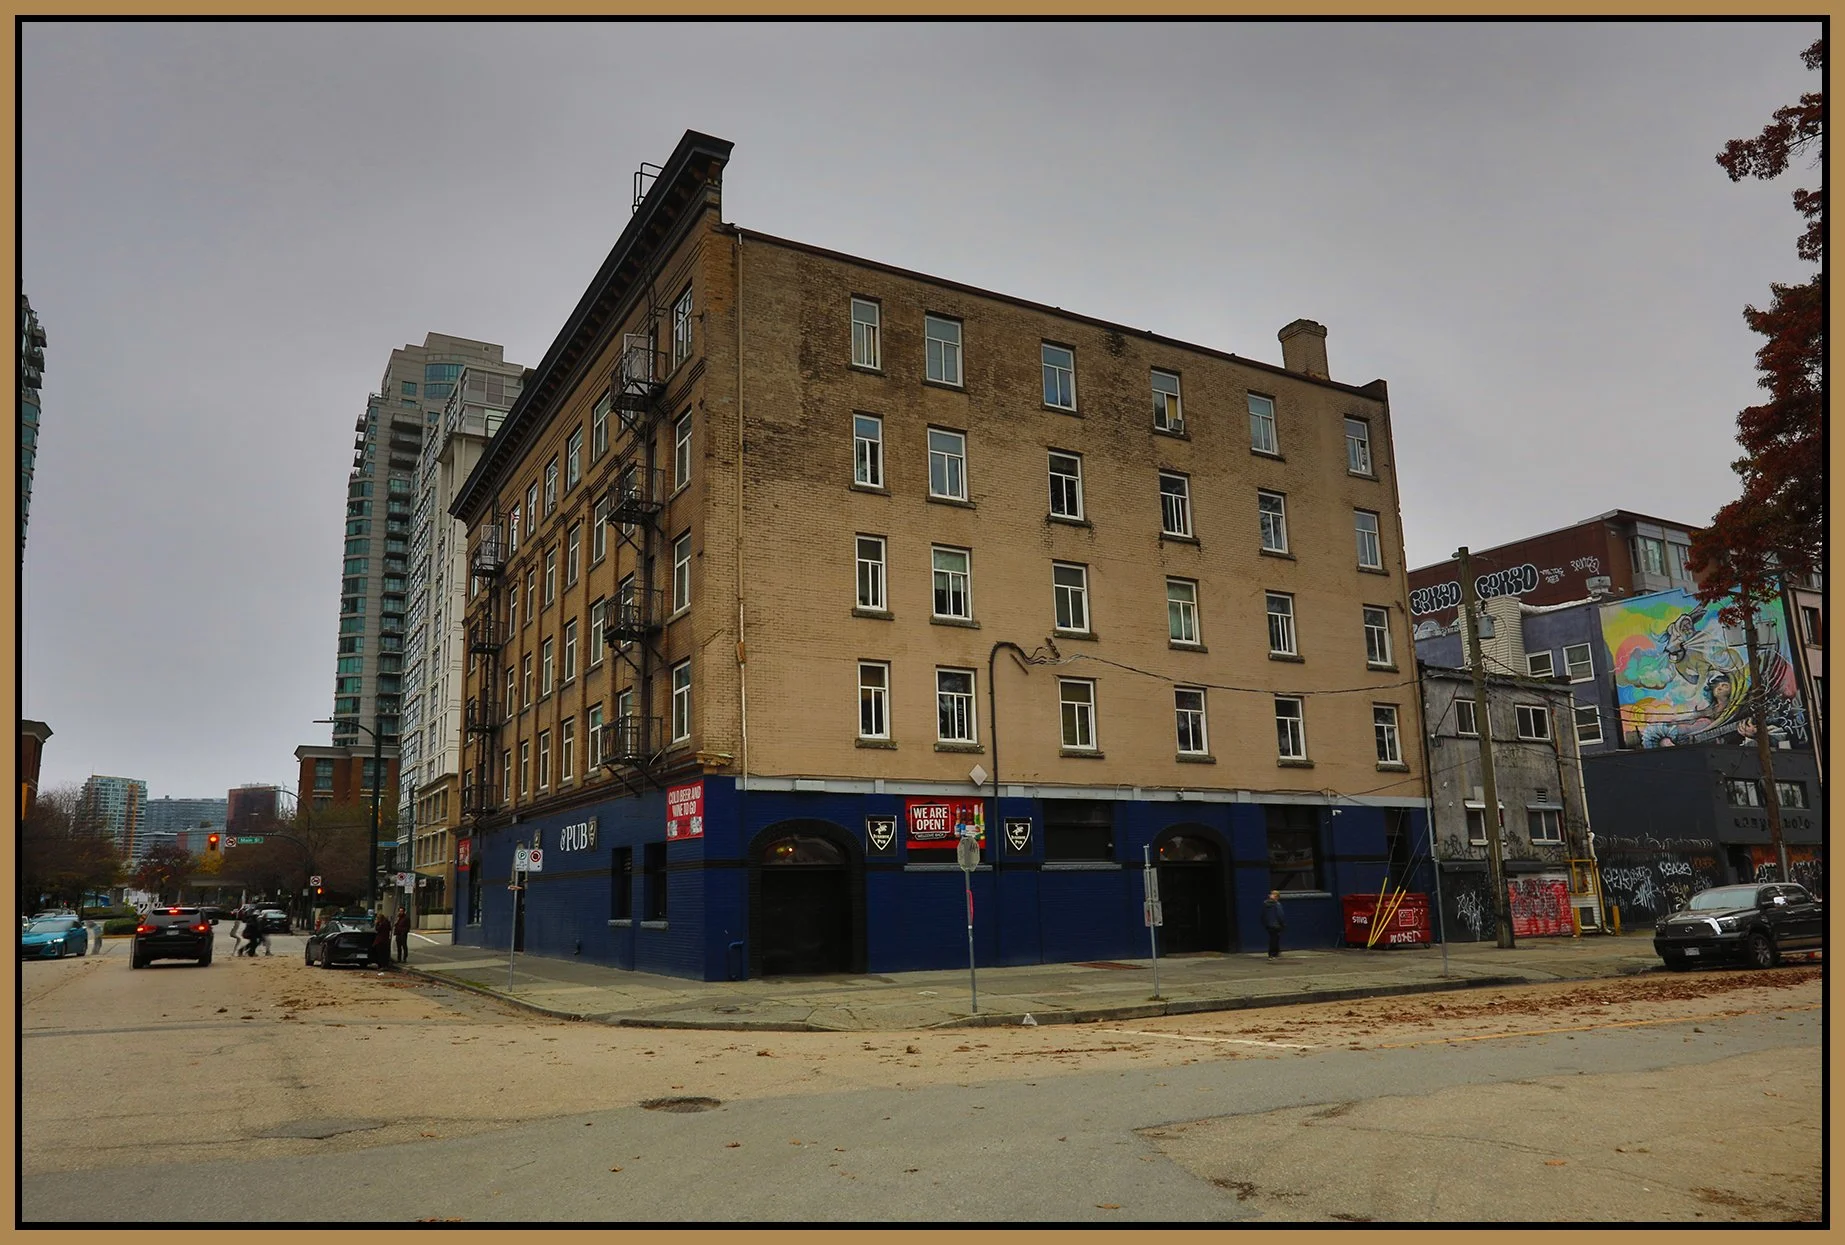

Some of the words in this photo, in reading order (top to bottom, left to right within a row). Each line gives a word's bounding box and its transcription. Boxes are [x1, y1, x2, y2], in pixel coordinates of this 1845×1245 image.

[668, 790, 679, 805] COLD
[680, 787, 691, 802] BEER
[691, 785, 702, 800] AND
[672, 803, 683, 818] WINE
[683, 802, 689, 816] TO
[689, 801, 697, 815] GO
[913, 807, 928, 819] WE
[929, 807, 948, 819] ARE
[916, 819, 945, 831] OPEN!
